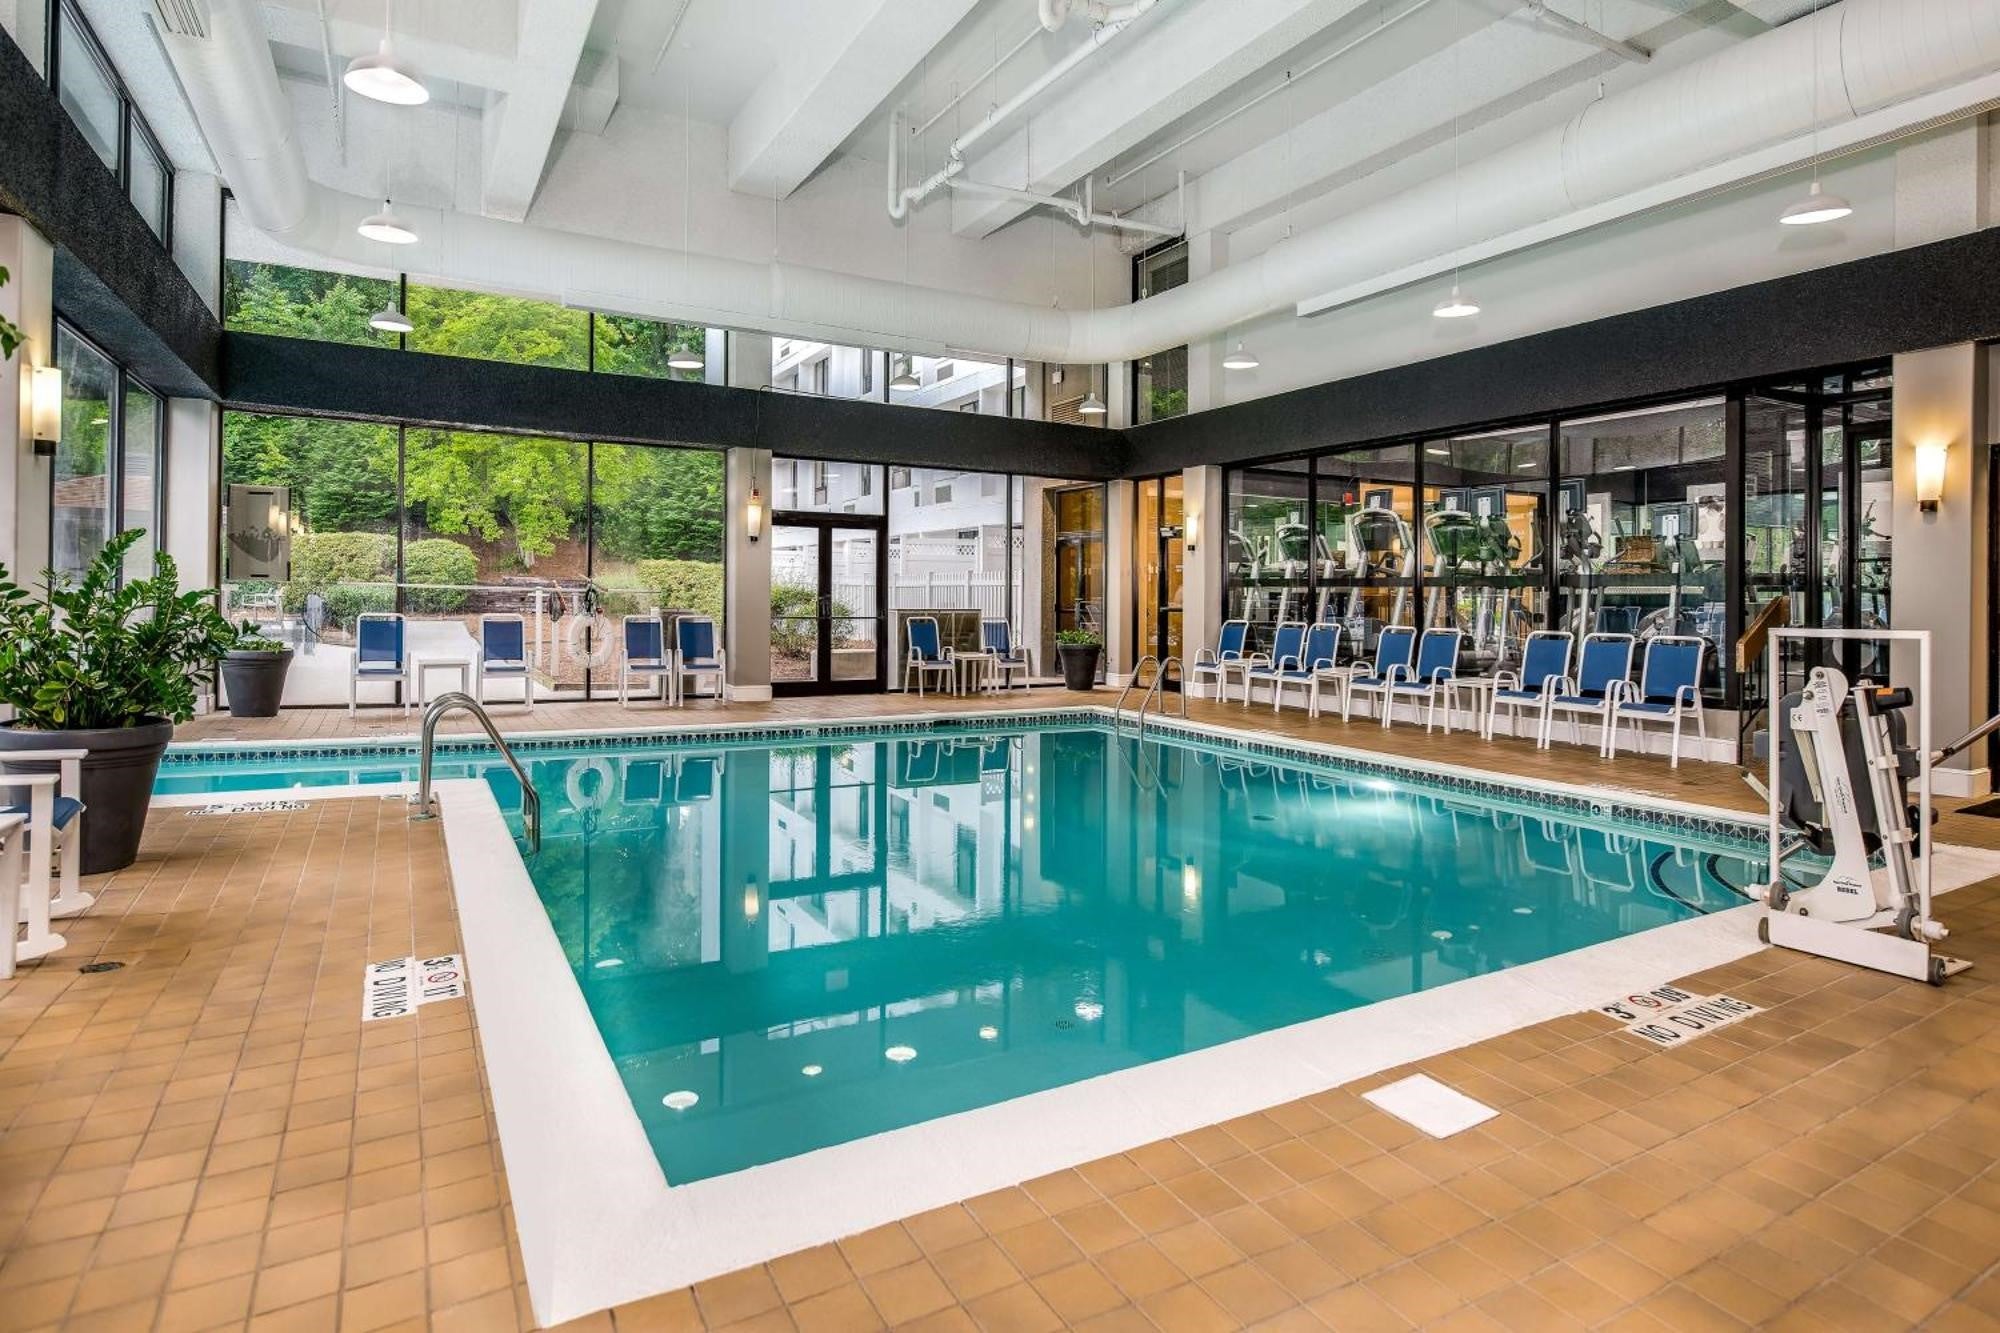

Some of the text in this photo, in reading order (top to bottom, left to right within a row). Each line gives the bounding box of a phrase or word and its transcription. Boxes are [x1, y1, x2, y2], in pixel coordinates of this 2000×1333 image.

[231, 803, 306, 813] DIVING
[372, 959, 407, 1018] NO DIVING
[1632, 997, 1753, 1044] NO DIVING
